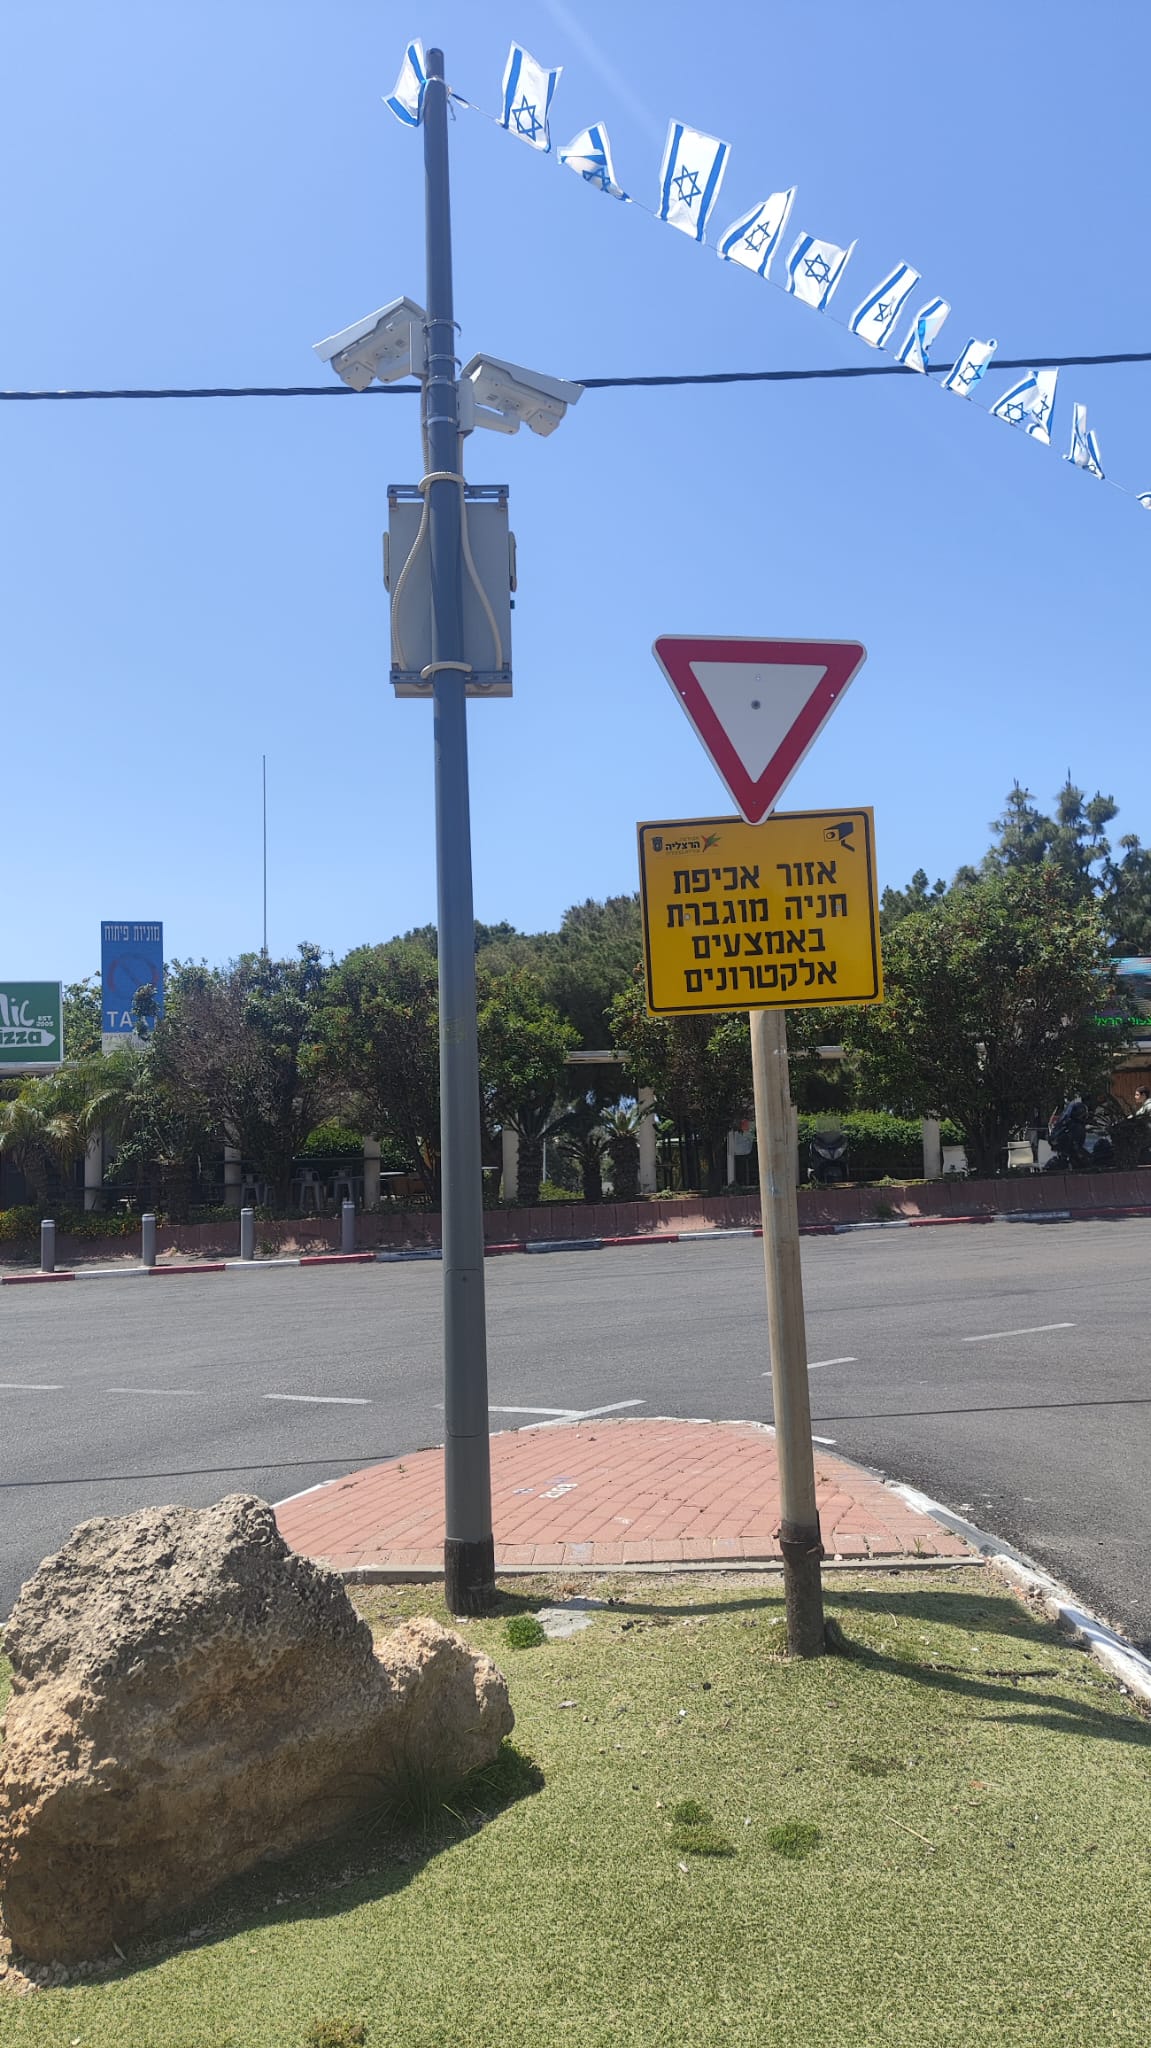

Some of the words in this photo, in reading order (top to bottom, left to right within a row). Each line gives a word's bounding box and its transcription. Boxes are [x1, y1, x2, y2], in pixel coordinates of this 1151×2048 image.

[665, 841, 701, 851] הרצליה
[673, 865, 760, 894] אכיפת
[776, 860, 837, 887] אזור
[666, 898, 769, 928] מוגברת
[784, 893, 848, 920] חניה
[104, 925, 129, 941] פיתוח
[133, 925, 160, 941] מוניות
[691, 928, 826, 960] באמצעים
[683, 958, 837, 993] אלקטרונים
